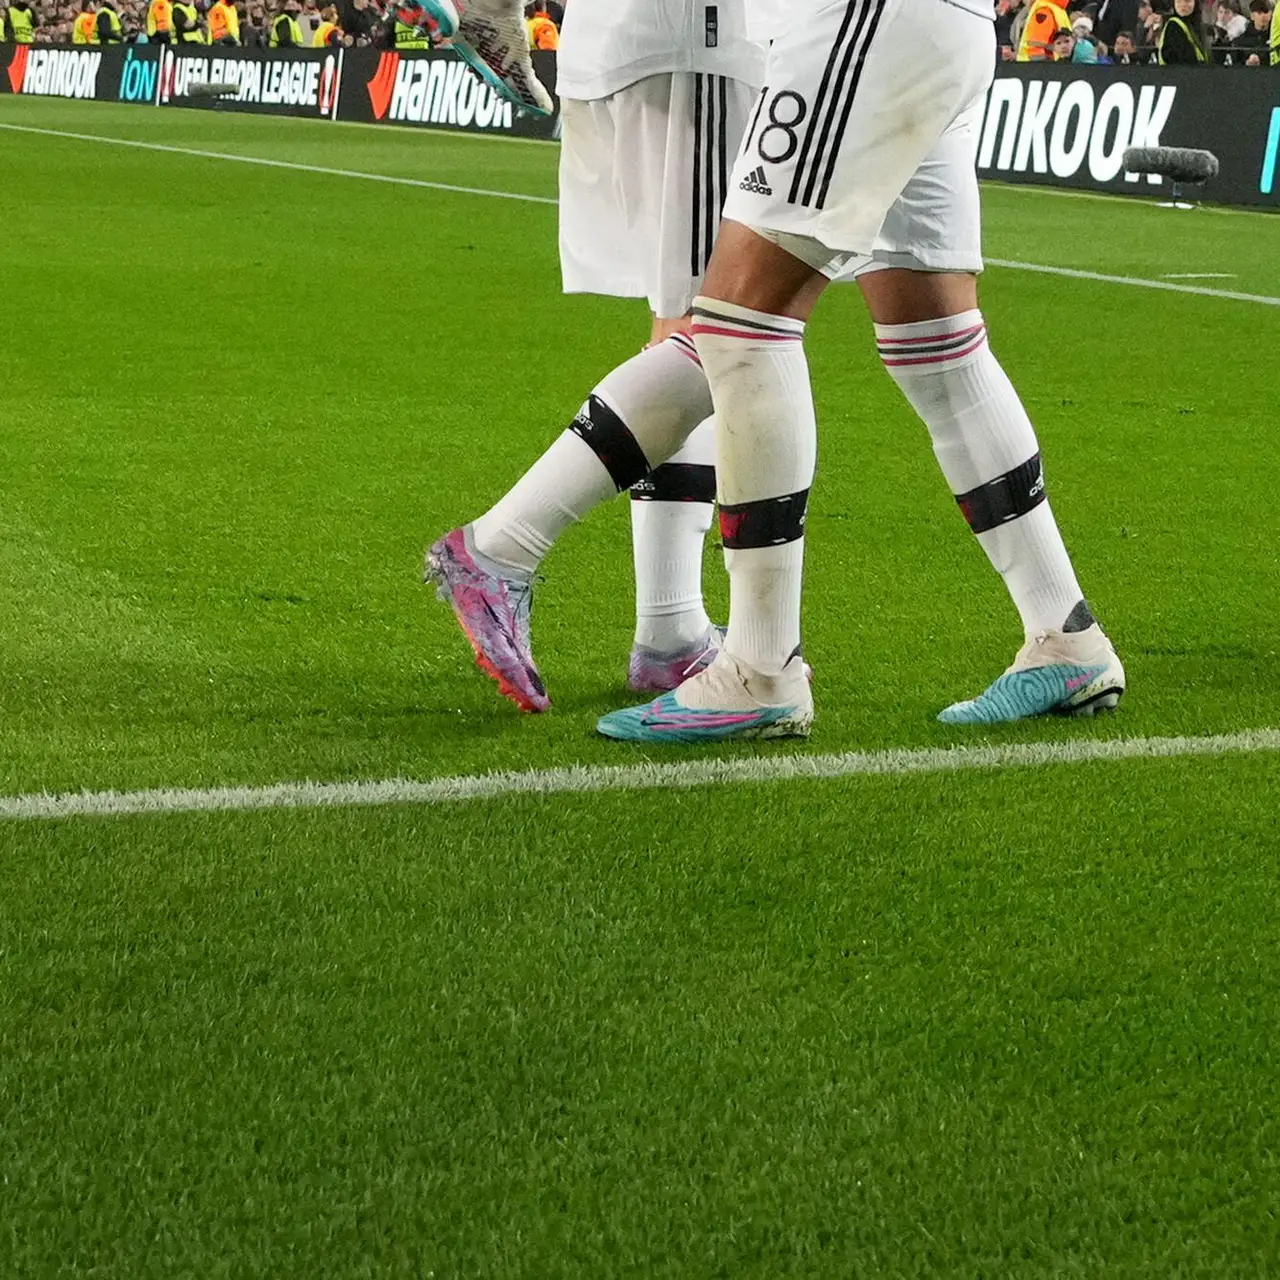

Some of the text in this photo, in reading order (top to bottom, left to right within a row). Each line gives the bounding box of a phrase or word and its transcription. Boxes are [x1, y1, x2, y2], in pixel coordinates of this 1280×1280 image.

[261, 61, 321, 106] LEAGUE
[743, 86, 807, 164] 18
[977, 78, 1177, 185] nKOOK
[739, 181, 773, 197] adidas
